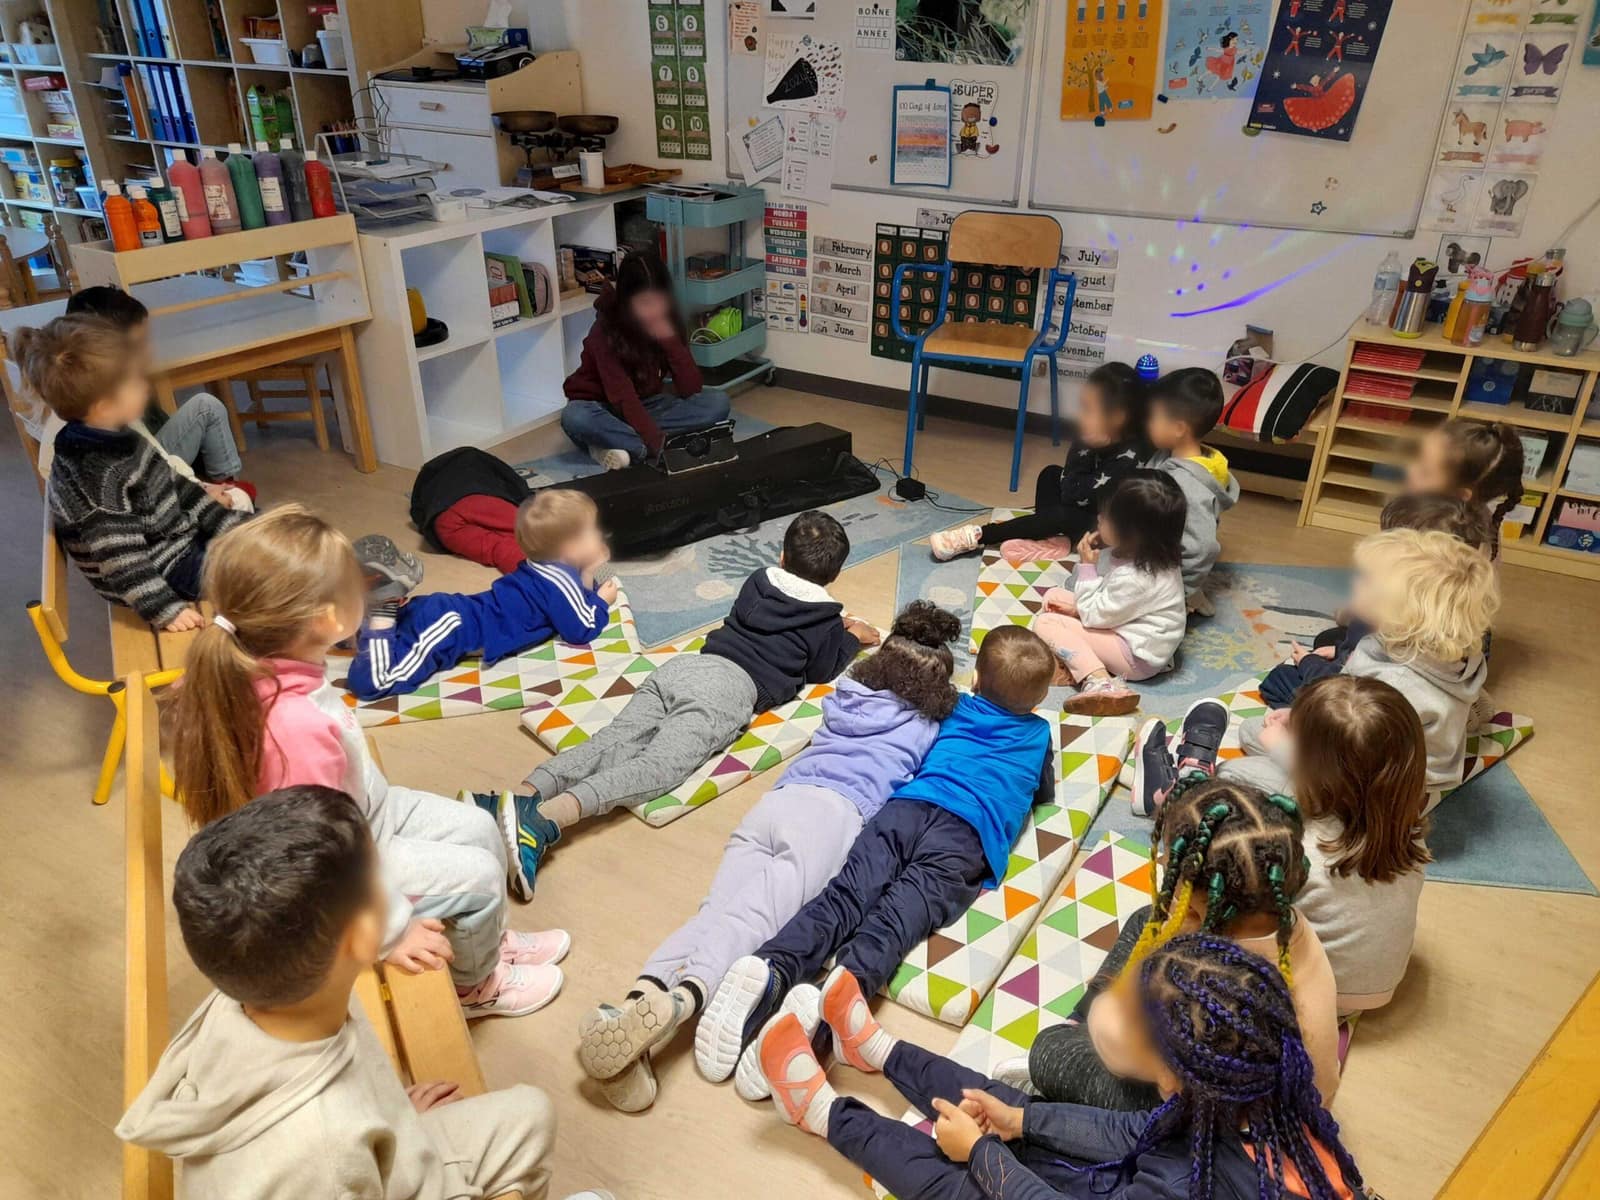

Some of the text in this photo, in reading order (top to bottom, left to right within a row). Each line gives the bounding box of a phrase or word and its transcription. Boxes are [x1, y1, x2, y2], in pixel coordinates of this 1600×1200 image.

[858, 8, 891, 16] BONNE
[658, 17, 665, 30] 5
[686, 17, 694, 30] 6
[662, 68, 668, 79] 7
[689, 68, 696, 80] 8
[956, 84, 994, 99] SUPER
[665, 117, 672, 128] 9
[692, 118, 702, 130] 10
[773, 210, 797, 218] MONDAY
[772, 218, 798, 227] TUESDAY
[769, 228, 800, 238] WEDNESDAY
[771, 238, 800, 246] THURSDAY
[776, 247, 796, 255] FRIDAY
[832, 240, 872, 259] February
[771, 256, 800, 265] SATURDAY
[1078, 250, 1101, 265] July
[776, 266, 798, 274] SUNDAY
[835, 262, 862, 276] March
[836, 283, 856, 296] April
[834, 302, 852, 318] May
[834, 324, 854, 336] June
